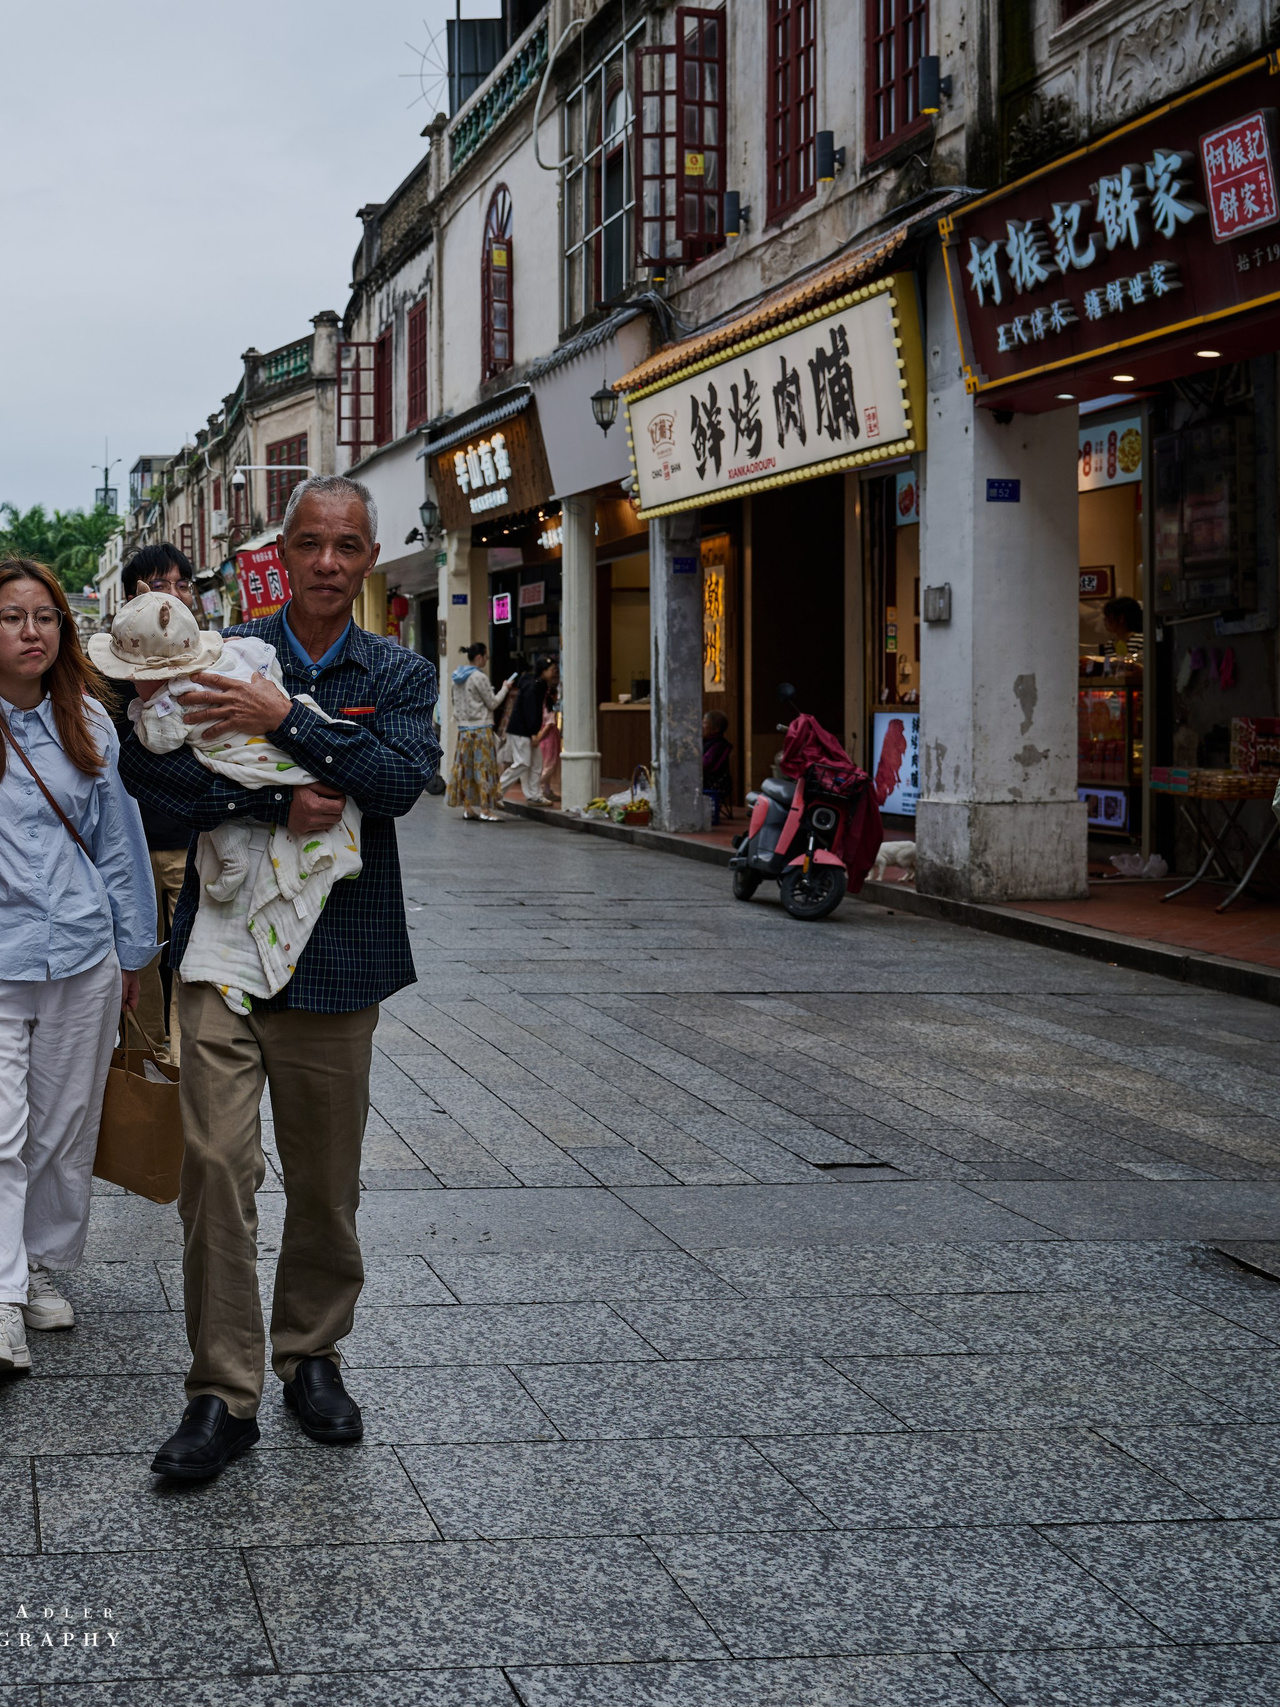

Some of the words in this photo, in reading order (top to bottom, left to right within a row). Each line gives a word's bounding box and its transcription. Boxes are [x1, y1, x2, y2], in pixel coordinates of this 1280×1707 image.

[1219, 182, 1261, 223] 餅家
[966, 151, 1195, 308] 柯振記餅家
[728, 457, 777, 480] XIANKAOROUPU
